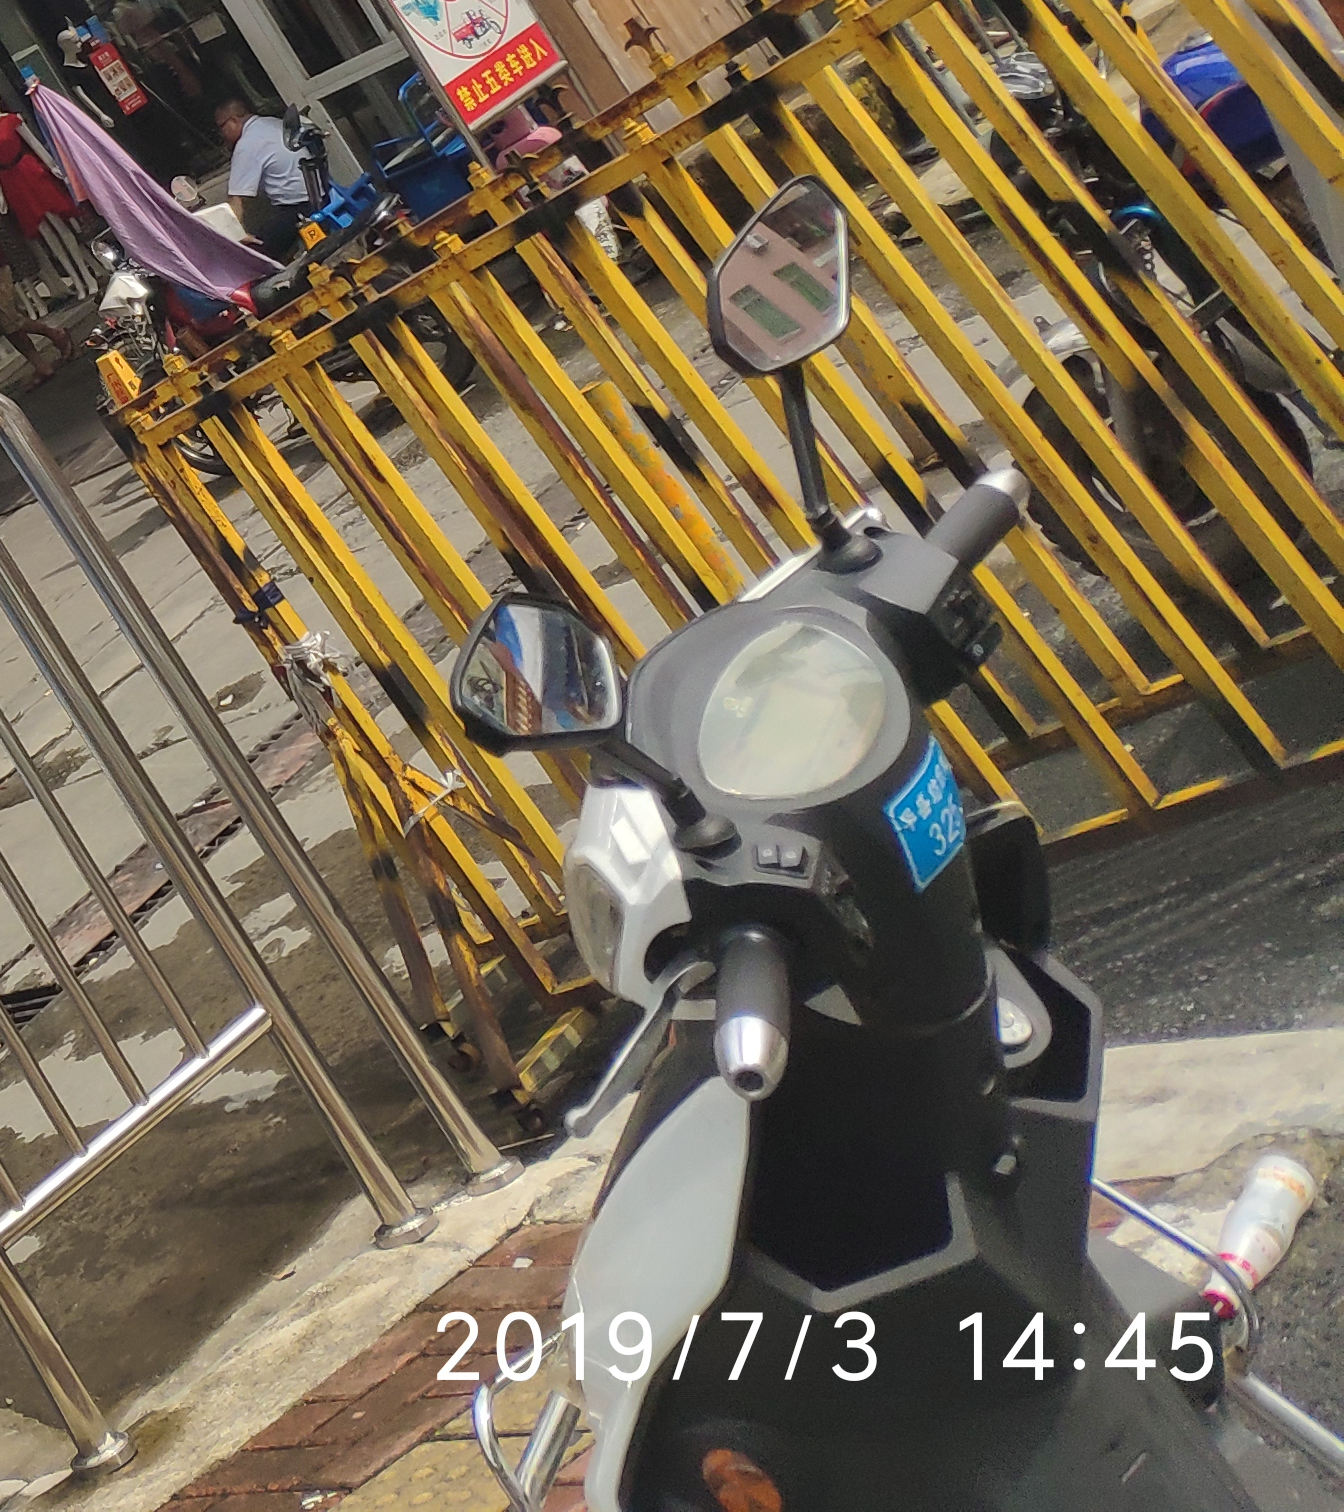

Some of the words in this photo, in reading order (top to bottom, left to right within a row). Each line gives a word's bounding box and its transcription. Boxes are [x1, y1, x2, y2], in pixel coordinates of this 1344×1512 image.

[456, 38, 548, 112] 禁止五类车进入
